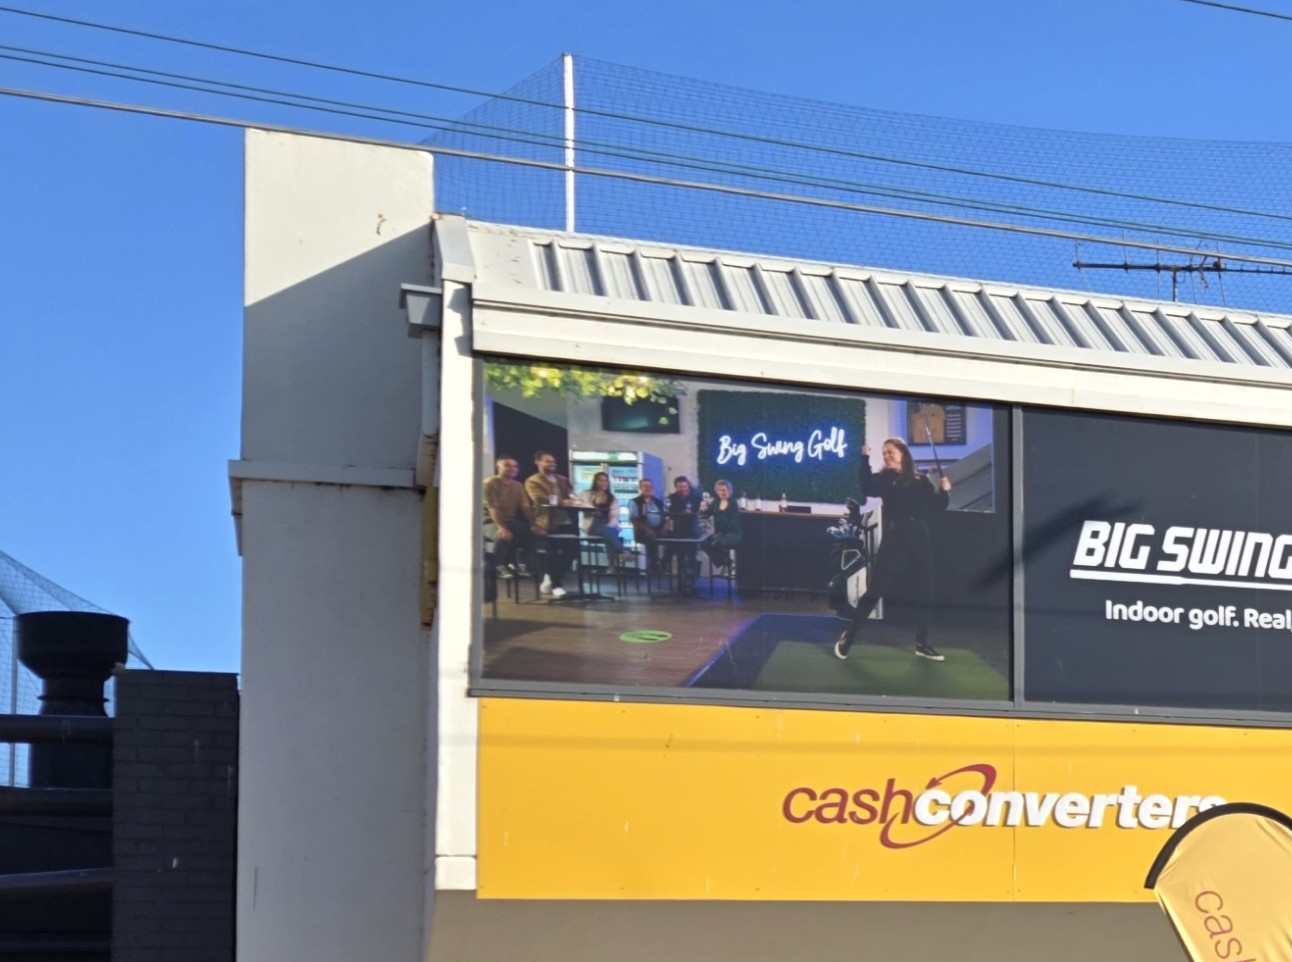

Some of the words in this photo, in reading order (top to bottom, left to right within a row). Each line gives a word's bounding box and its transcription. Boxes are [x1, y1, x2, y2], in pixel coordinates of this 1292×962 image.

[717, 434, 747, 466] Big
[751, 432, 804, 464] Swing
[807, 426, 848, 461] Golf
[1073, 520, 1156, 571] BIG
[1105, 599, 1185, 624] Indoor
[1188, 605, 1239, 630] golf.
